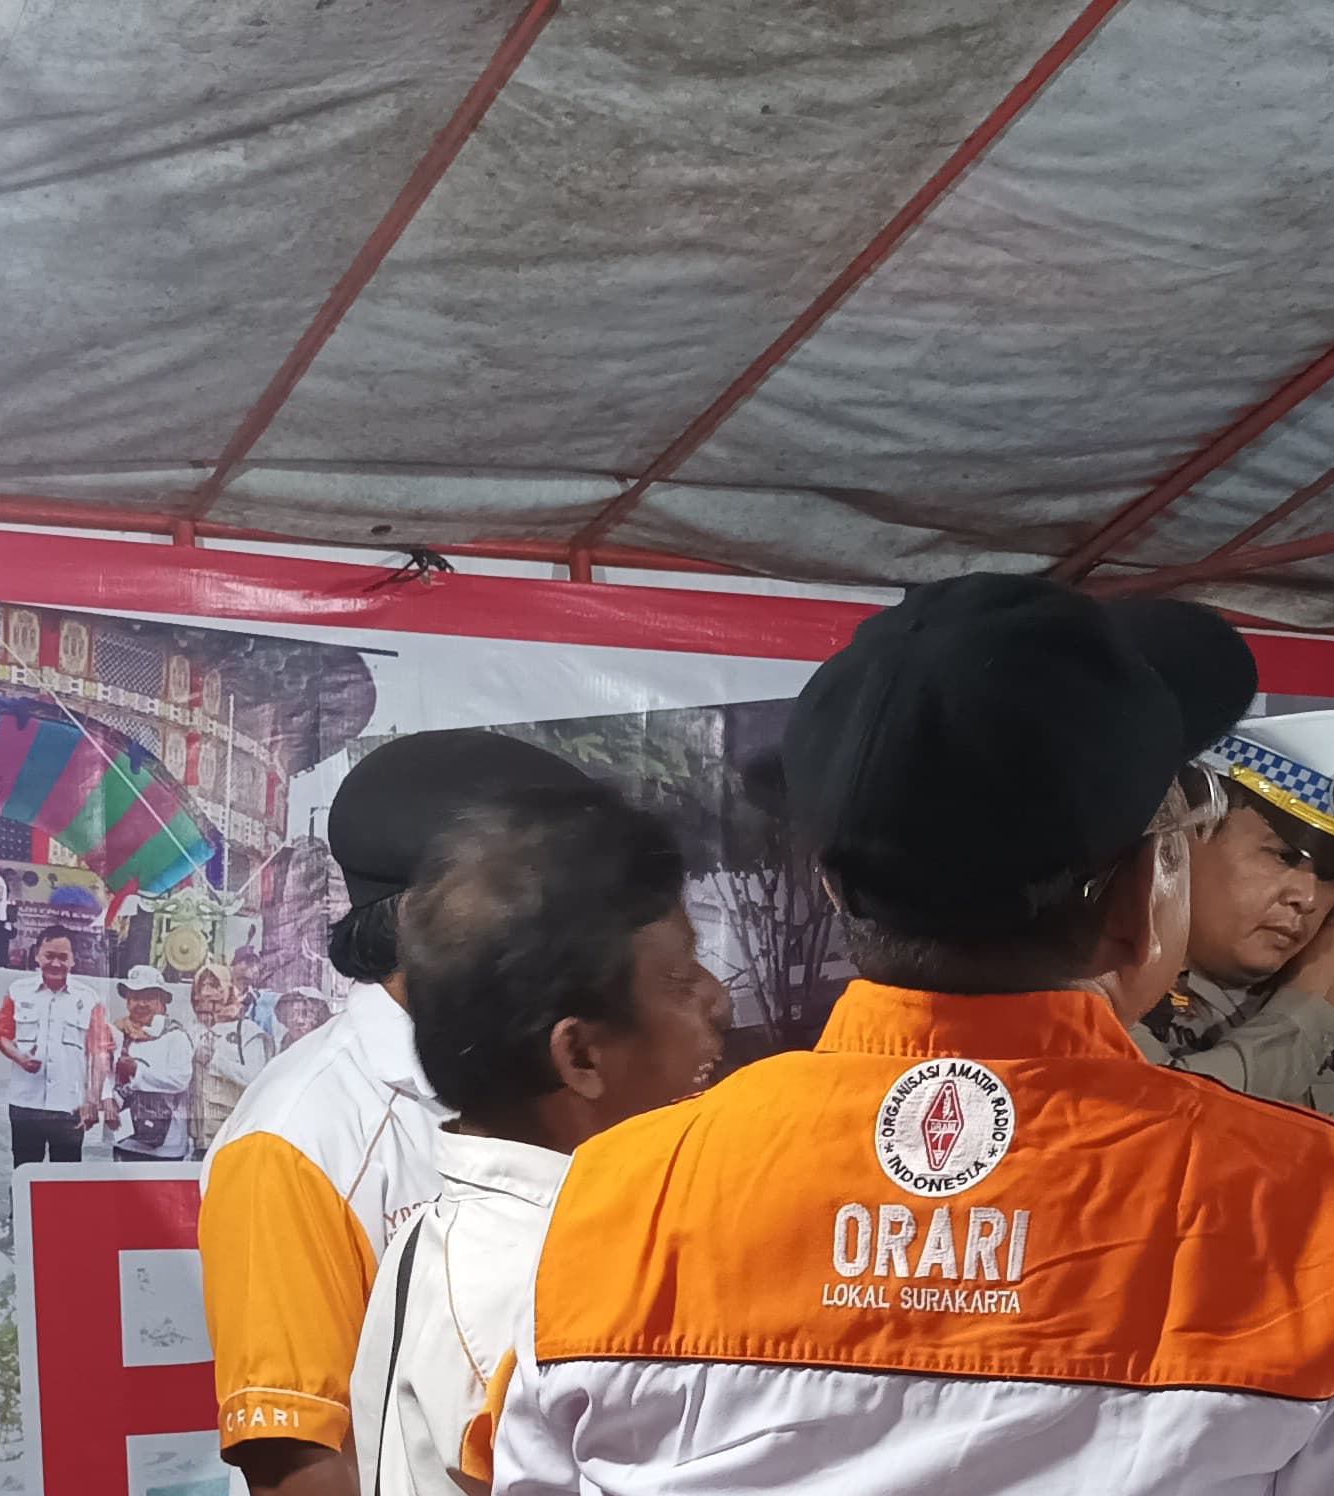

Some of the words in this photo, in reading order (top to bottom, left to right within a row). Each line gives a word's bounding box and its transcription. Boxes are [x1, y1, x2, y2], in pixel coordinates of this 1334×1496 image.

[882, 1064, 940, 1137] ORGANISASI
[946, 1062, 998, 1096] AMATIR
[991, 1097, 1009, 1142] RADIO
[887, 1154, 987, 1192] INDONESIA
[833, 1202, 1031, 1282] ORARI
[822, 1283, 890, 1309] LOKAL
[900, 1287, 1021, 1314] SURAKARTA
